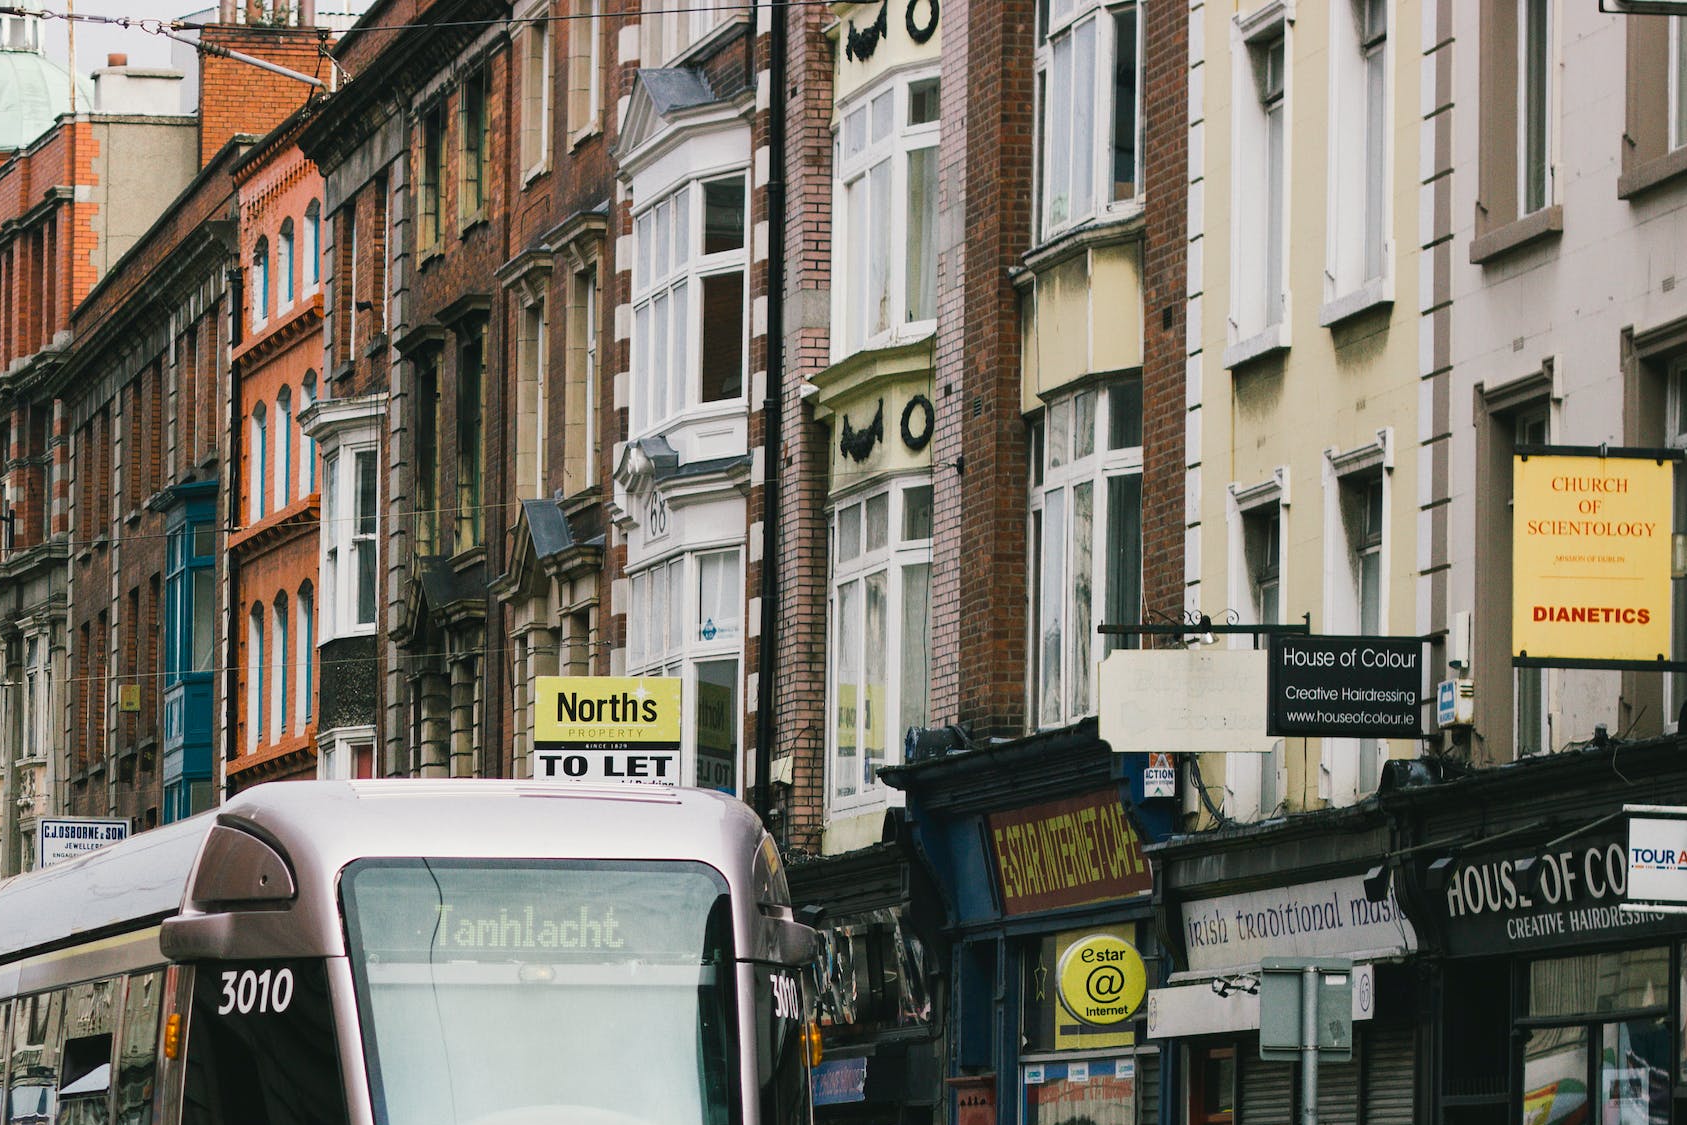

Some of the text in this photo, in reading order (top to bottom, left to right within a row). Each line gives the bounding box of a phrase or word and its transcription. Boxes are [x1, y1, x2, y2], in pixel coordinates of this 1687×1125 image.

[1551, 477, 1629, 493] CHURCH
[651, 491, 666, 537] 68
[1578, 499, 1602, 514] OF
[1527, 520, 1656, 537] SCIENTOLOGY
[1533, 606, 1650, 625] DIANETICS
[1283, 648, 1416, 668] House of Colour
[1285, 686, 1416, 706] Creative Hairdressing
[557, 692, 658, 722] Norths
[1286, 709, 1415, 725] www.houseofcolour.ie
[568, 728, 644, 738] PROPERTY
[540, 755, 672, 777] TO LET
[1038, 806, 1106, 893] INTERNET
[1631, 848, 1675, 865] TOUR
[1447, 843, 1627, 917] HOUS OF CO
[435, 904, 624, 948] Tamhlacht
[1188, 909, 1229, 948] irish
[1236, 892, 1343, 941] traditional
[1507, 912, 1566, 940] CREATIVE
[218, 967, 294, 1015] 3010
[770, 974, 799, 1020] 3010
[1085, 1004, 1129, 1017] Internet
